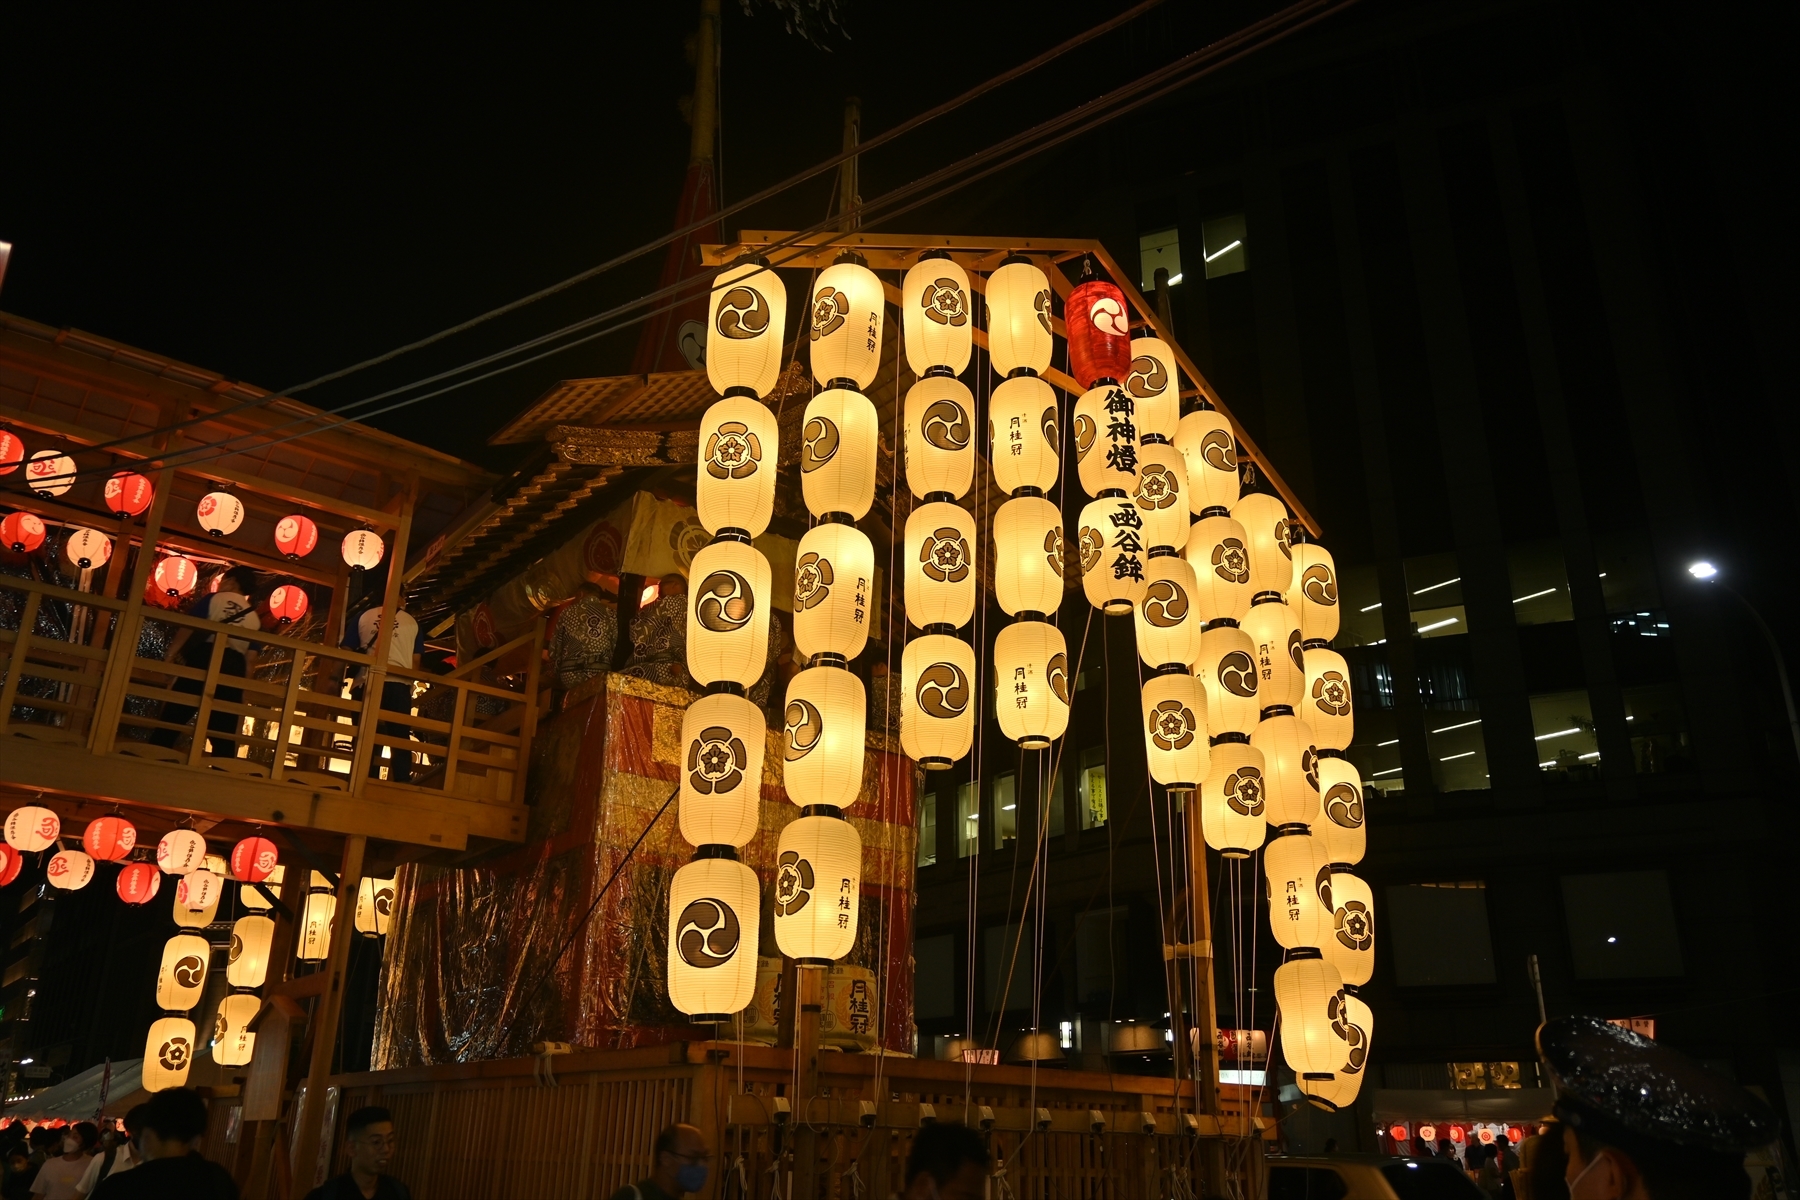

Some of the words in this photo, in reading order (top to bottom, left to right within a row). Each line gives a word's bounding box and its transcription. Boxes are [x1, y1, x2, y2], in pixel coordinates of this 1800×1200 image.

[866, 311, 877, 353] 月桂冠
[1009, 416, 1022, 456] 月桂冠
[1103, 388, 1138, 476] 御神燈
[1108, 502, 1145, 584] 函谷鉾
[854, 577, 866, 624] 月桂冠
[1259, 644, 1272, 680] 月桂冠
[1014, 667, 1028, 709] 月桂冠
[838, 878, 851, 930] 月桂冠
[1286, 881, 1300, 921] 月桂冠
[849, 979, 869, 1035] 月桂冠
